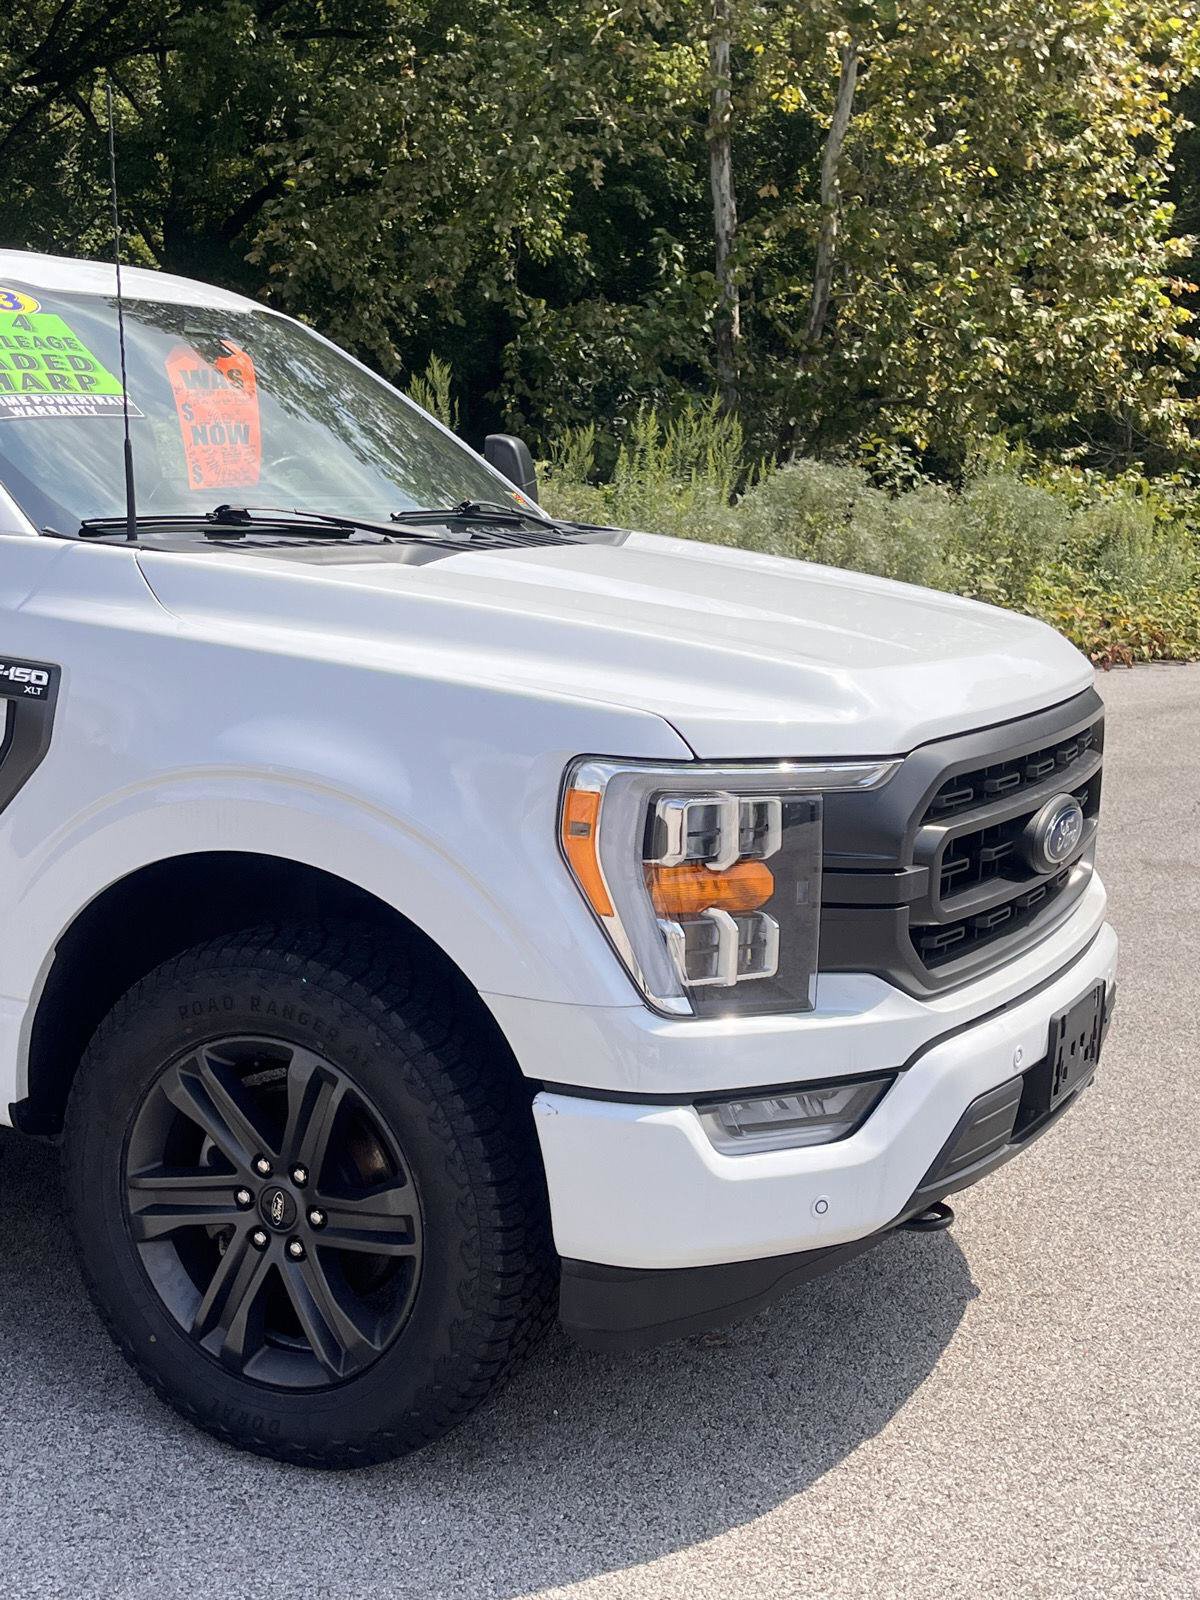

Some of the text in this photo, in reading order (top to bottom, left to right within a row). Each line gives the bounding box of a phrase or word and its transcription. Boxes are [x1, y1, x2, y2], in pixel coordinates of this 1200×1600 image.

[0, 335, 82, 352] LEAGE
[179, 368, 244, 390] WAS
[8, 405, 98, 416] WARRANTY
[191, 424, 250, 446] NOW
[24, 685, 43, 696] XLT
[250, 995, 340, 1042] RANGER
